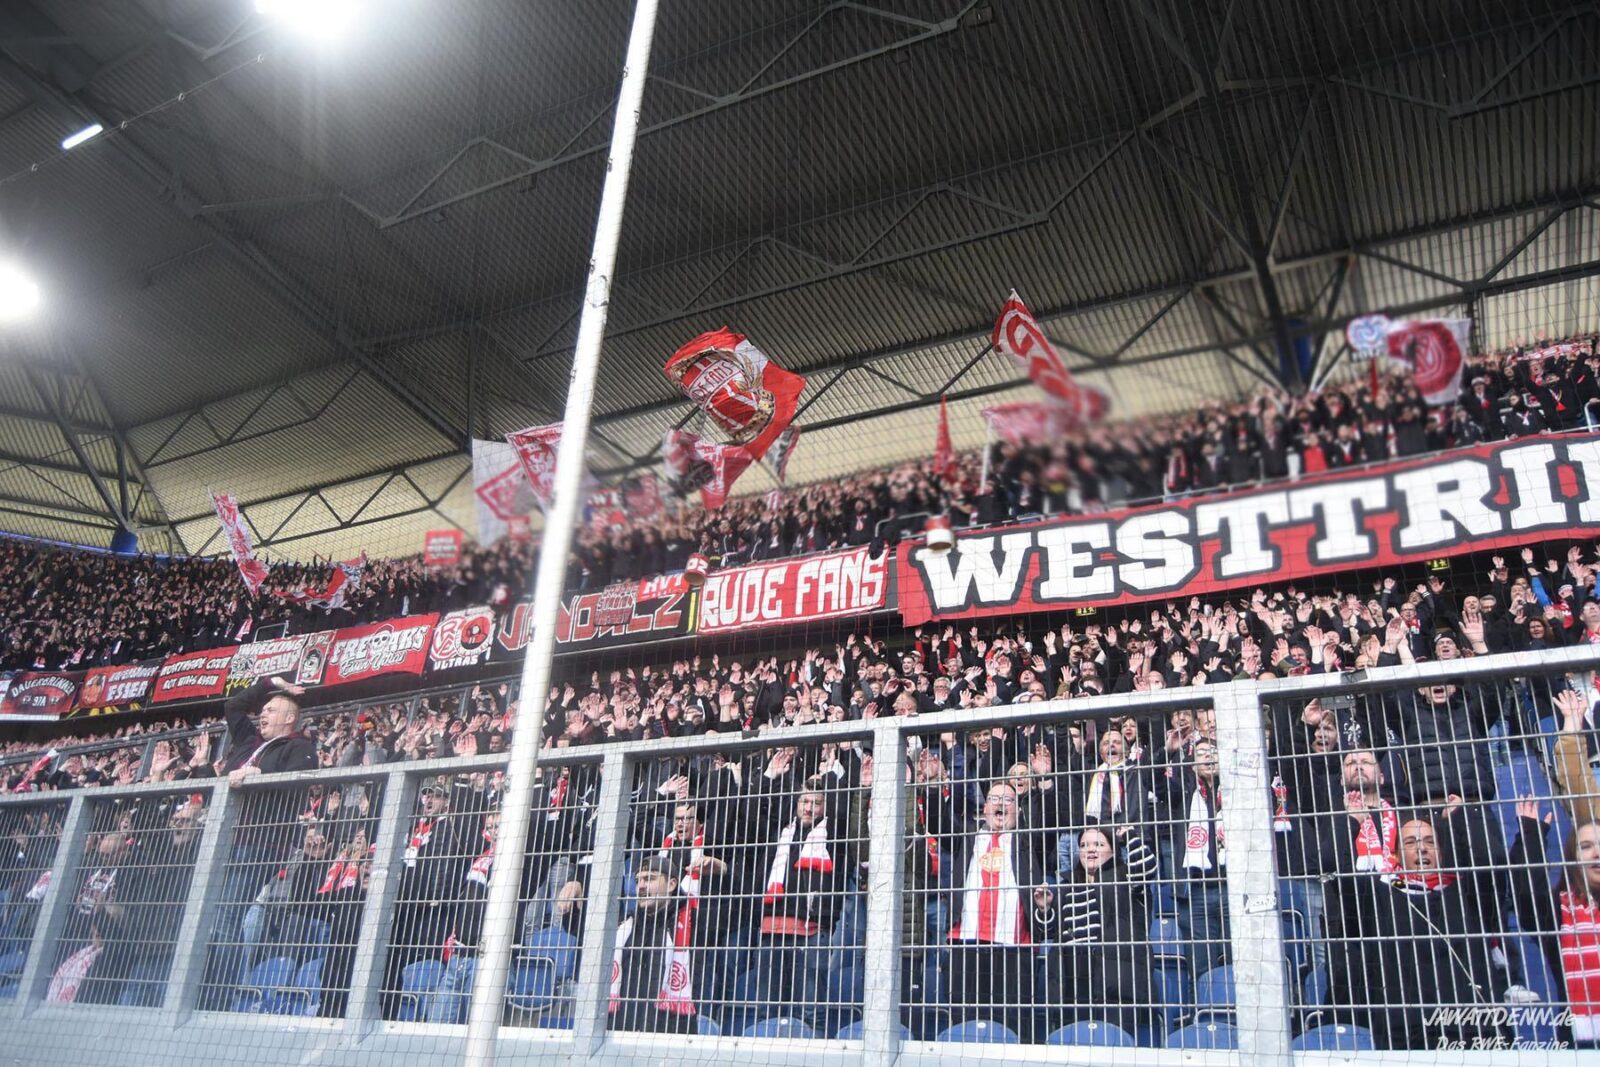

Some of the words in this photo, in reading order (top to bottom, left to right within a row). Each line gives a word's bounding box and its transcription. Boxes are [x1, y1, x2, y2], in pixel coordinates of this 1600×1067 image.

[701, 567, 789, 628] RUDE
[795, 552, 887, 616] FANS
[433, 655, 479, 671] ULTRAS
